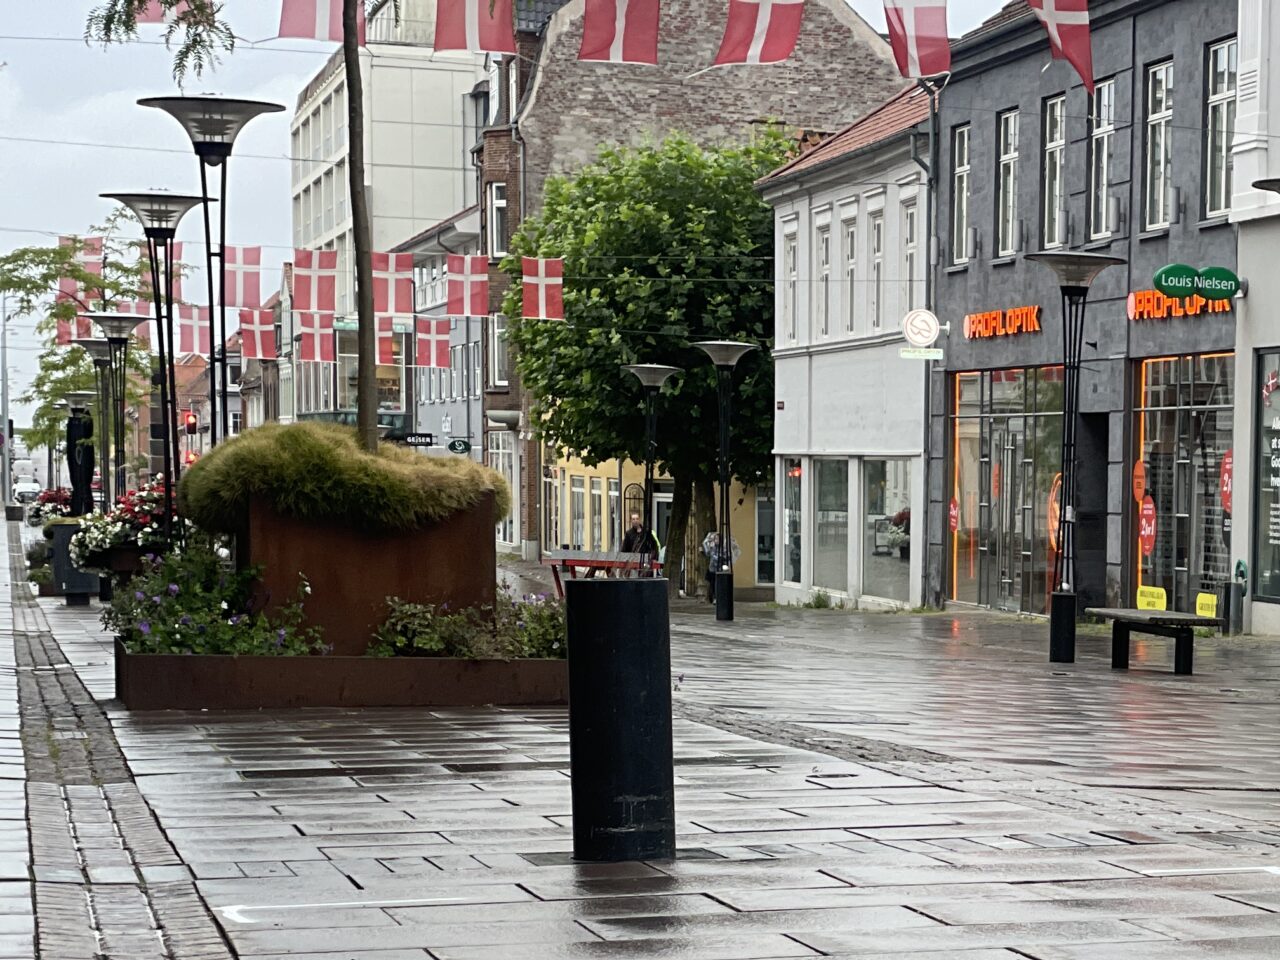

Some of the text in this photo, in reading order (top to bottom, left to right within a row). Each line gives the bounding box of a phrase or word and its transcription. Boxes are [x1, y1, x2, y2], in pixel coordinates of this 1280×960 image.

[1161, 273, 1236, 291] Louis Nielsen
[969, 305, 1041, 339] PROFIL OPTIK
